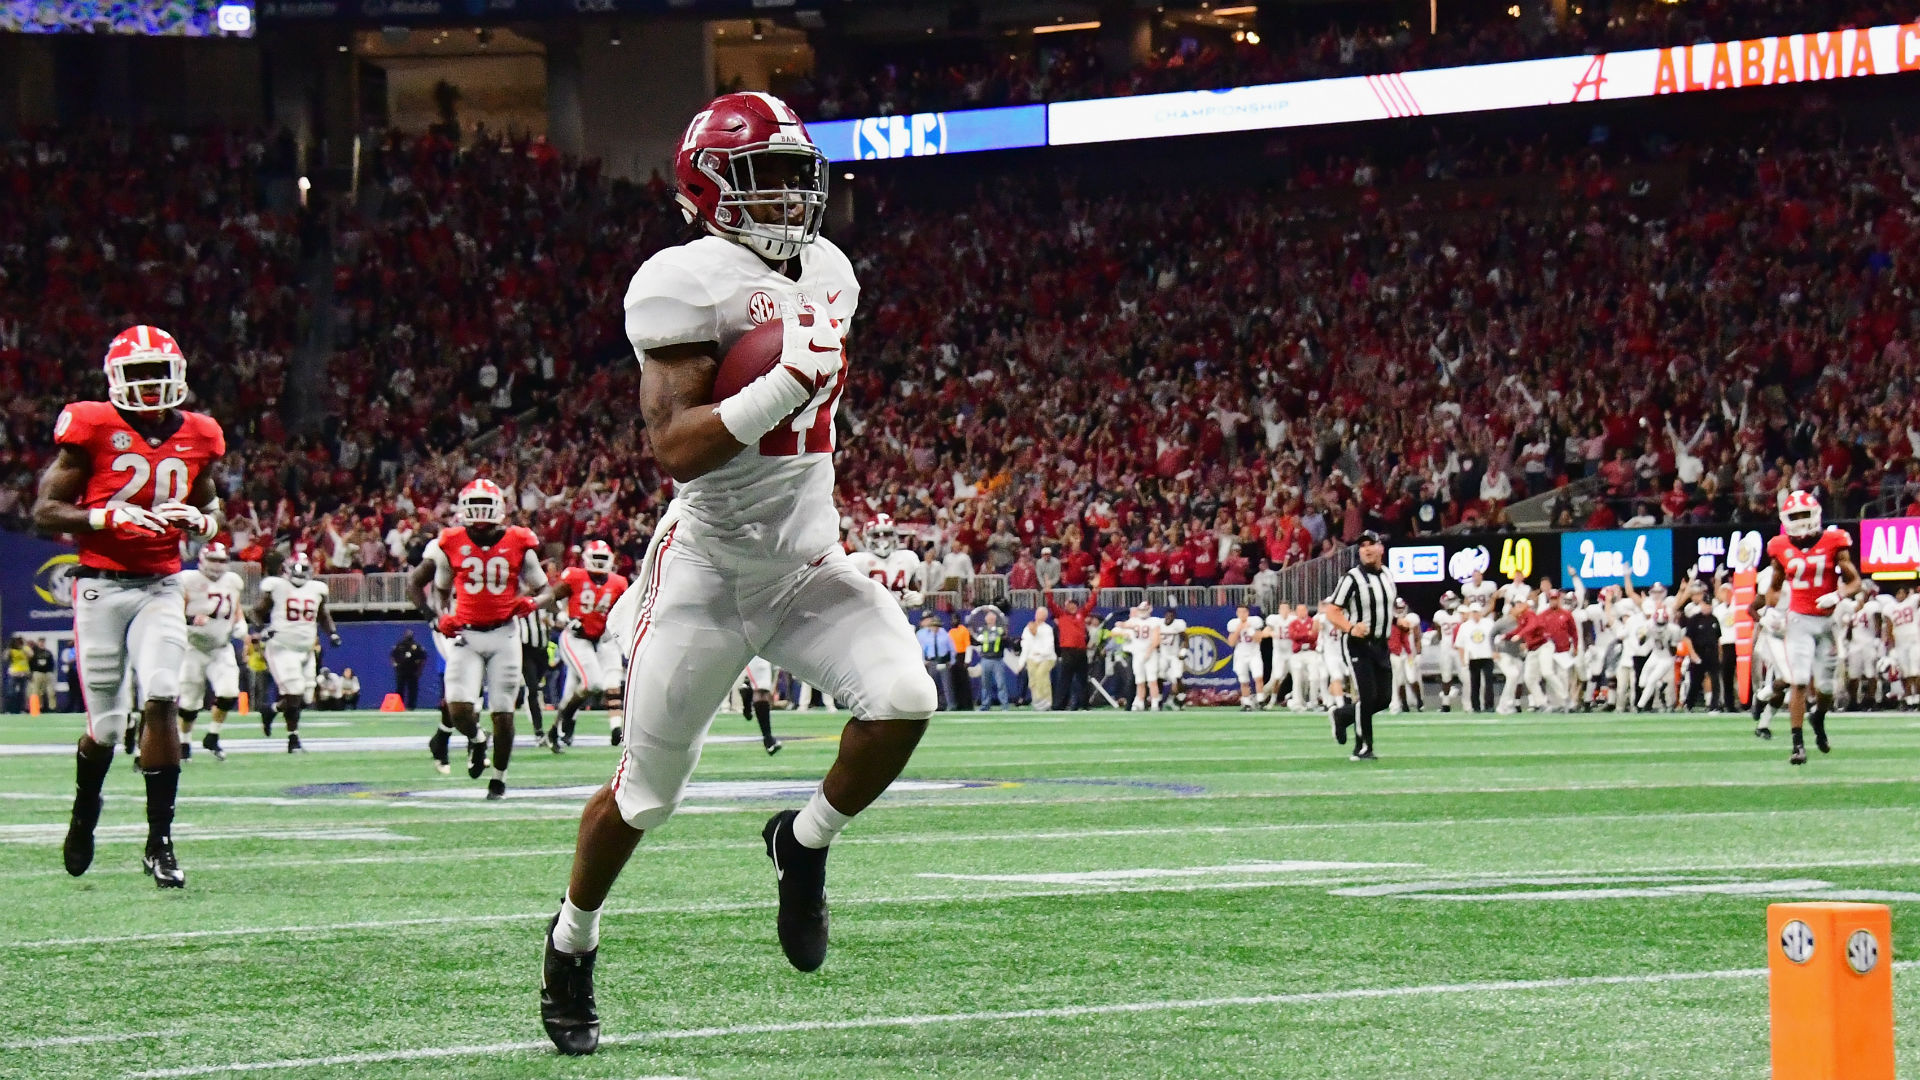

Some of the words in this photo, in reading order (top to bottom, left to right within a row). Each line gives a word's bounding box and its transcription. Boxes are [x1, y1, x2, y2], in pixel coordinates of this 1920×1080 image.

[1653, 28, 1877, 95] ALABAMA
[1154, 99, 1290, 122] CHAMPIONSHIP
[860, 112, 938, 160] SEC
[750, 290, 774, 324] SEC
[105, 453, 188, 512] 20
[1500, 538, 1533, 580] 40
[1632, 535, 1650, 577] 6
[1868, 525, 1920, 564] ALA
[461, 556, 510, 595] 30
[1787, 555, 1827, 590] 27
[83, 589, 99, 600] G
[207, 593, 232, 619] 71
[287, 598, 315, 621] 66
[580, 589, 613, 616] 94
[1185, 635, 1215, 673] SEC
[1781, 920, 1814, 962] SEC
[1848, 930, 1877, 973] SEC
